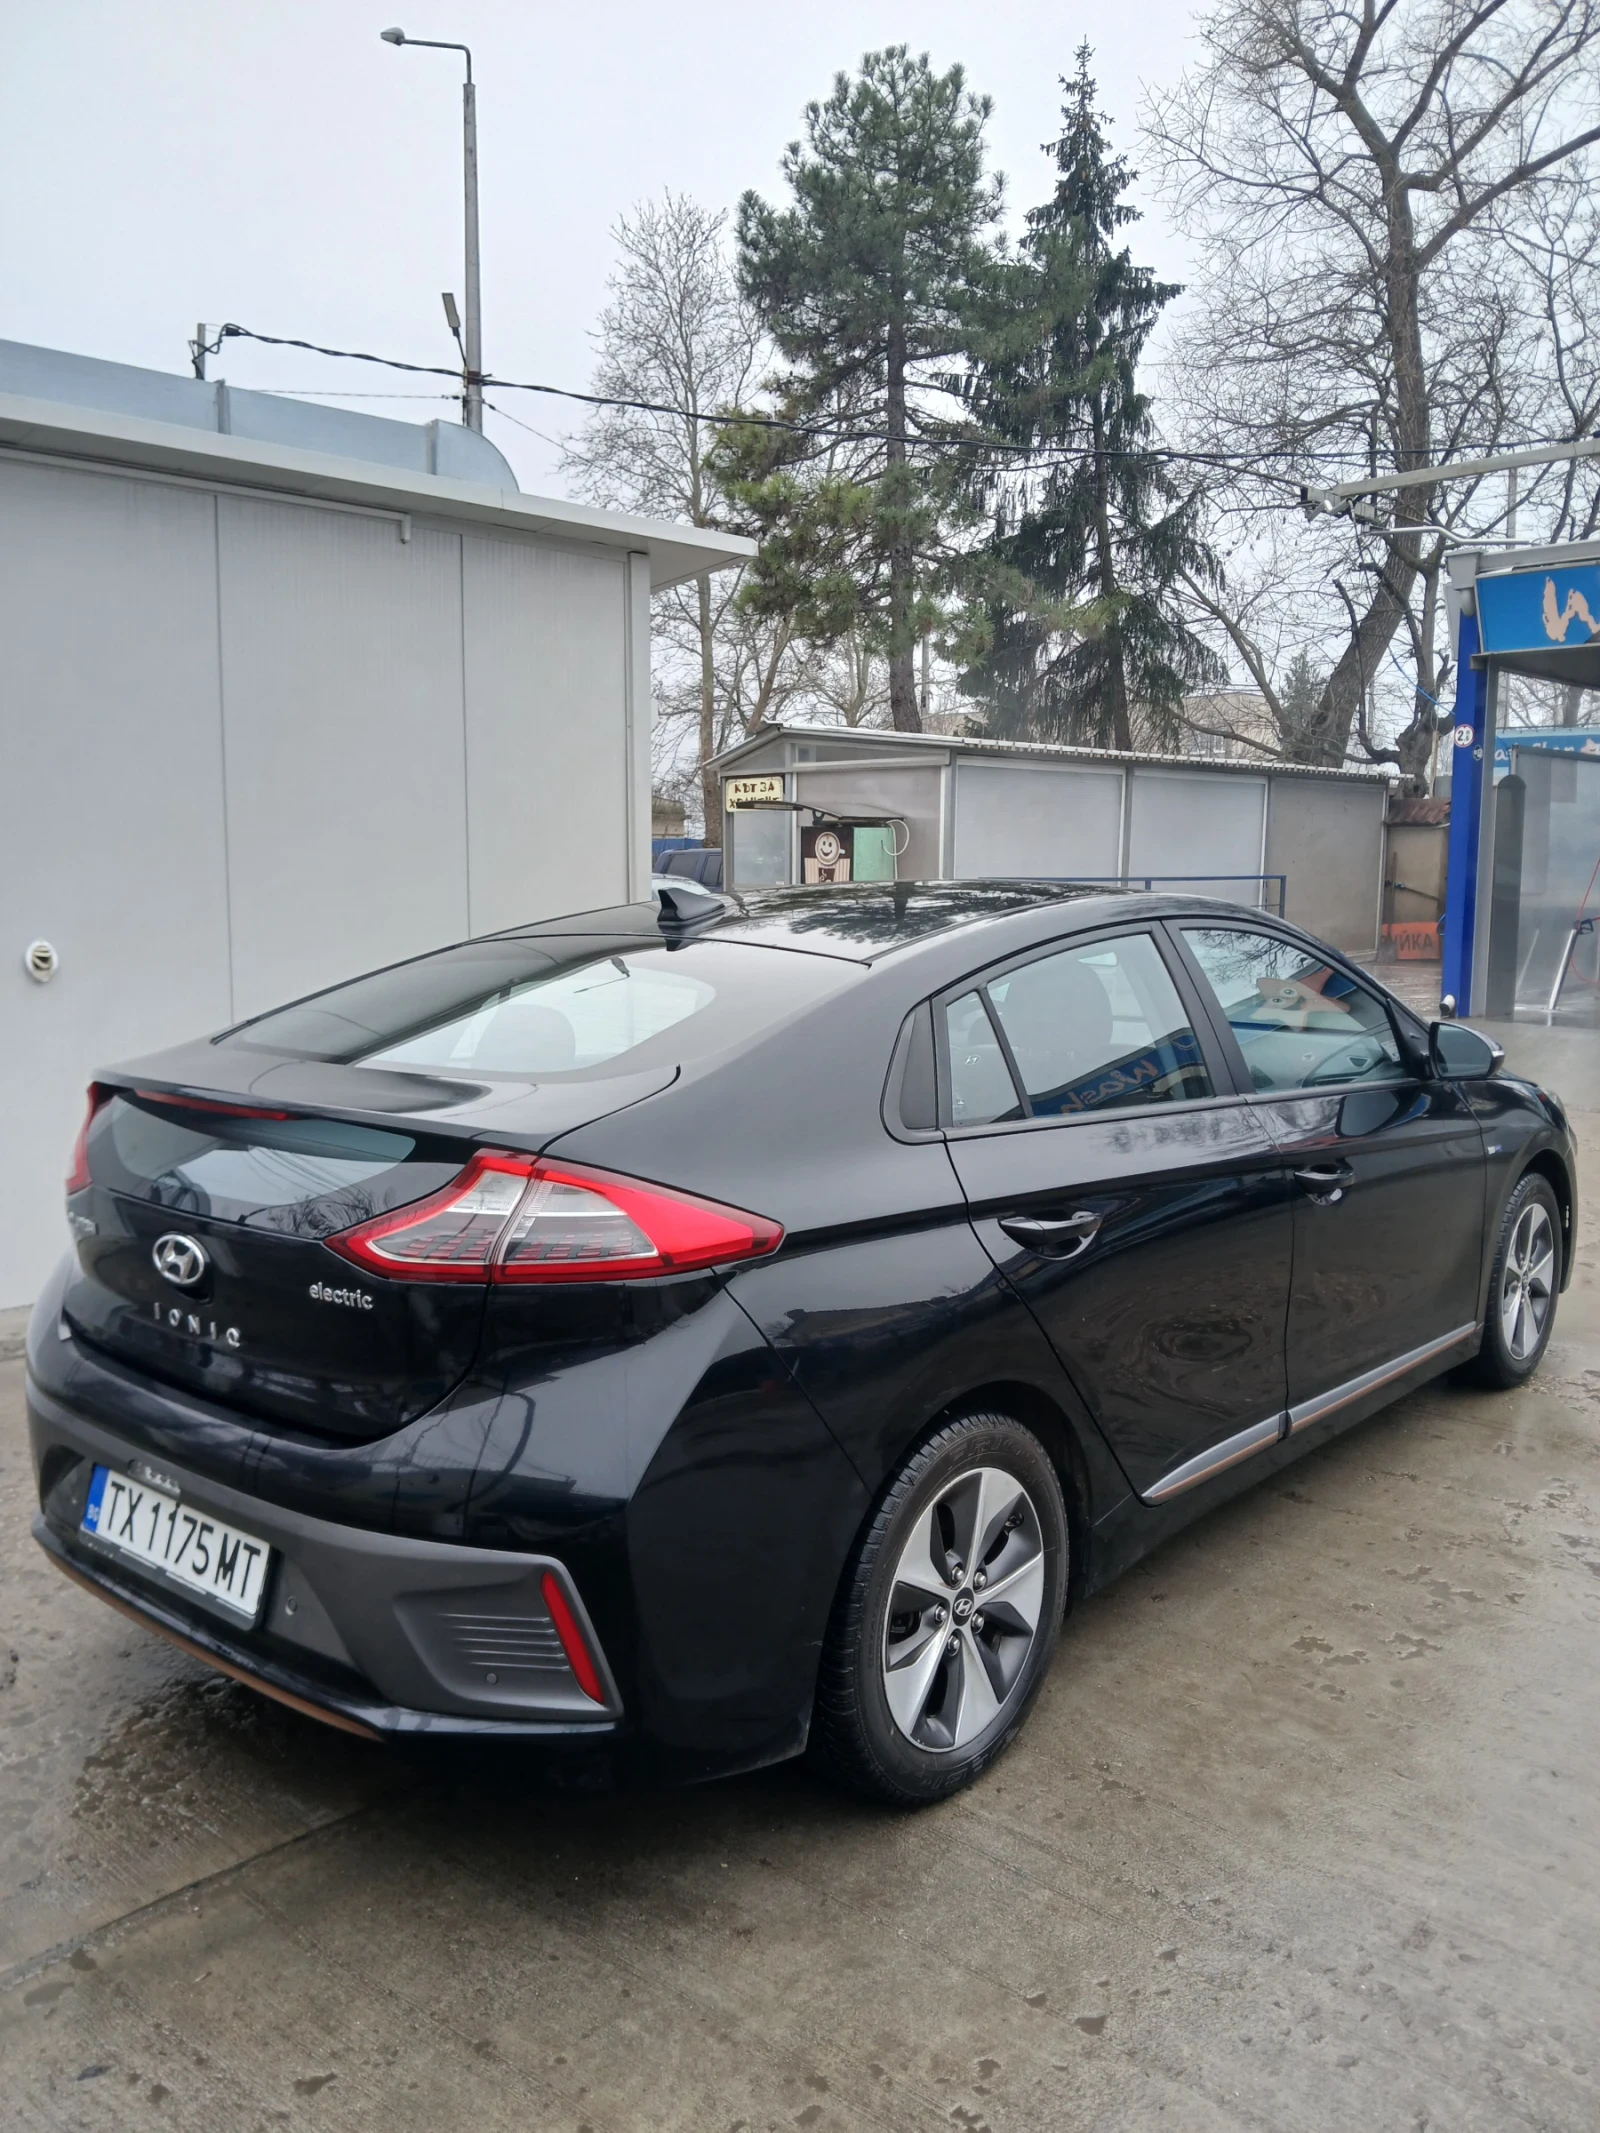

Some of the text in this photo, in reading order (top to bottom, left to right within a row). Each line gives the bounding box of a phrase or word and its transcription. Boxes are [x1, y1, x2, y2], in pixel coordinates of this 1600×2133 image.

[734, 781, 775, 794] КЪТ ЗА
[309, 1282, 374, 1310] electric
[153, 1302, 241, 1347] IONIQ
